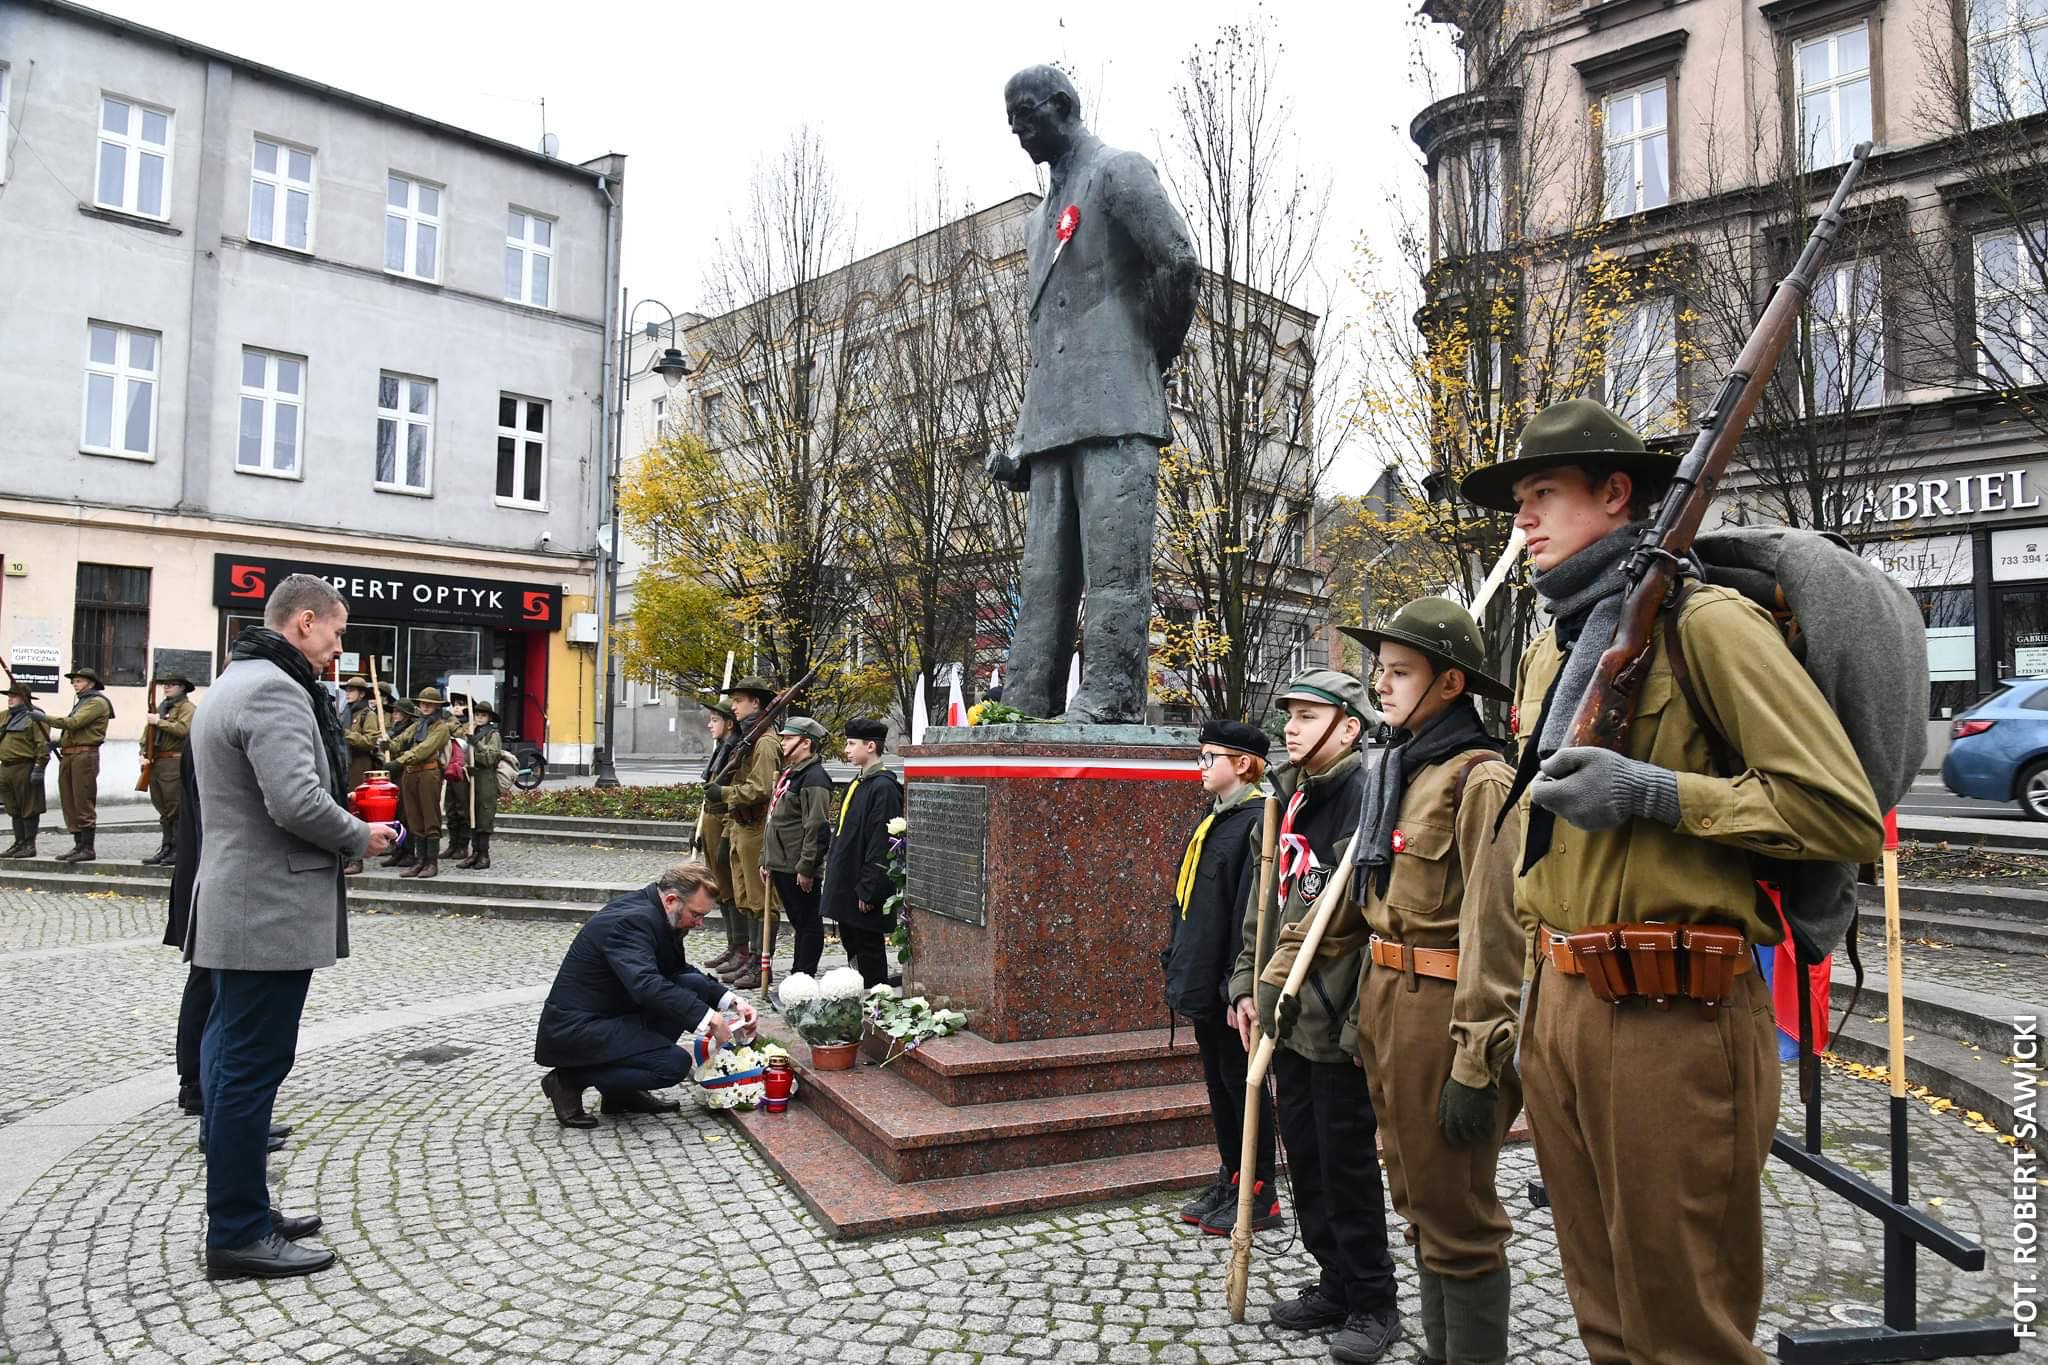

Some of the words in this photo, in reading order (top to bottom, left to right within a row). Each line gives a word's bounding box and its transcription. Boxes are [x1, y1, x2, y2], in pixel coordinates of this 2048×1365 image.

[1822, 470, 2040, 527] GABRIEL
[13, 563, 23, 571] 10
[1882, 554, 1942, 573] BRIEL
[2000, 556, 2018, 565] 733
[2022, 555, 2041, 564] 394
[291, 573, 403, 600] PERT
[413, 584, 503, 609] OPTYK
